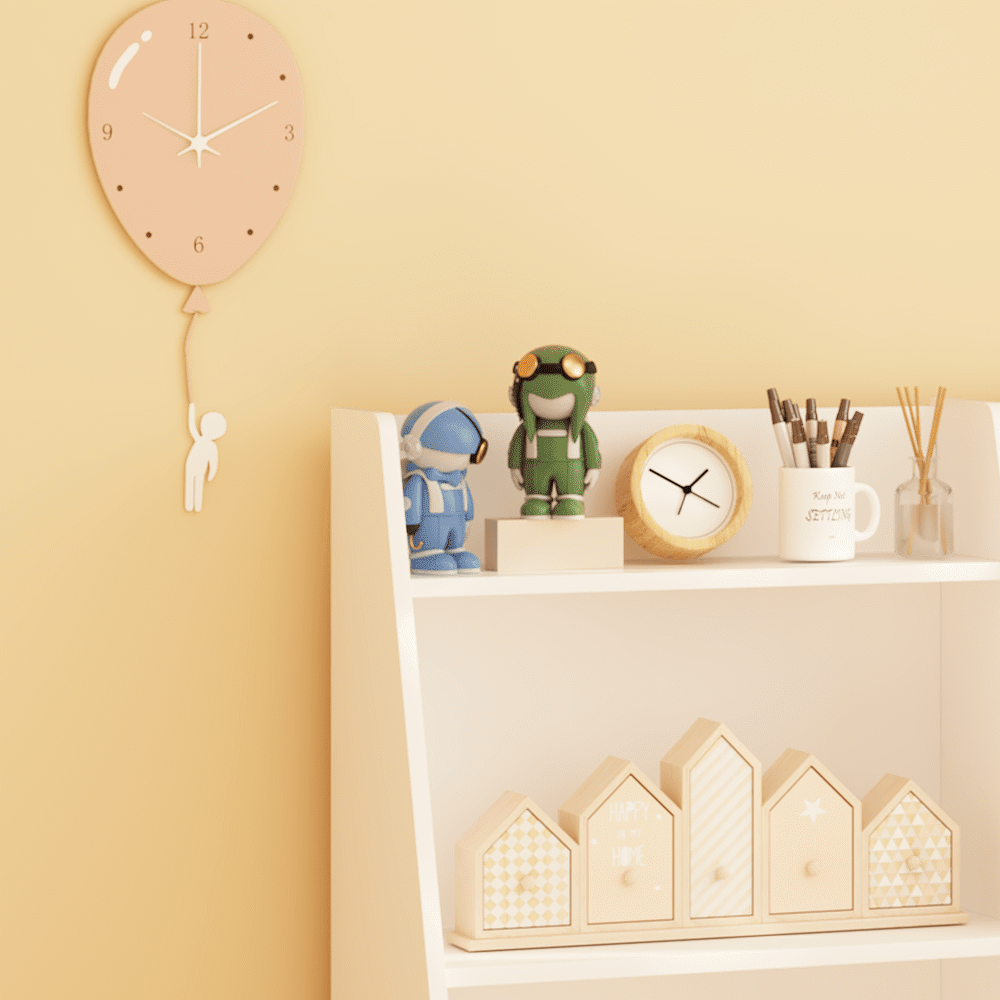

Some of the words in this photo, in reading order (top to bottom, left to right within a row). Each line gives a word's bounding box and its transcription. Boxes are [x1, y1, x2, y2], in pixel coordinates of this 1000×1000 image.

[189, 22, 209, 39] 12
[102, 123, 113, 141] 9
[284, 124, 295, 141] 3
[193, 236, 204, 253] 6
[608, 801, 651, 822] HAPPY
[611, 844, 646, 867] HOME
